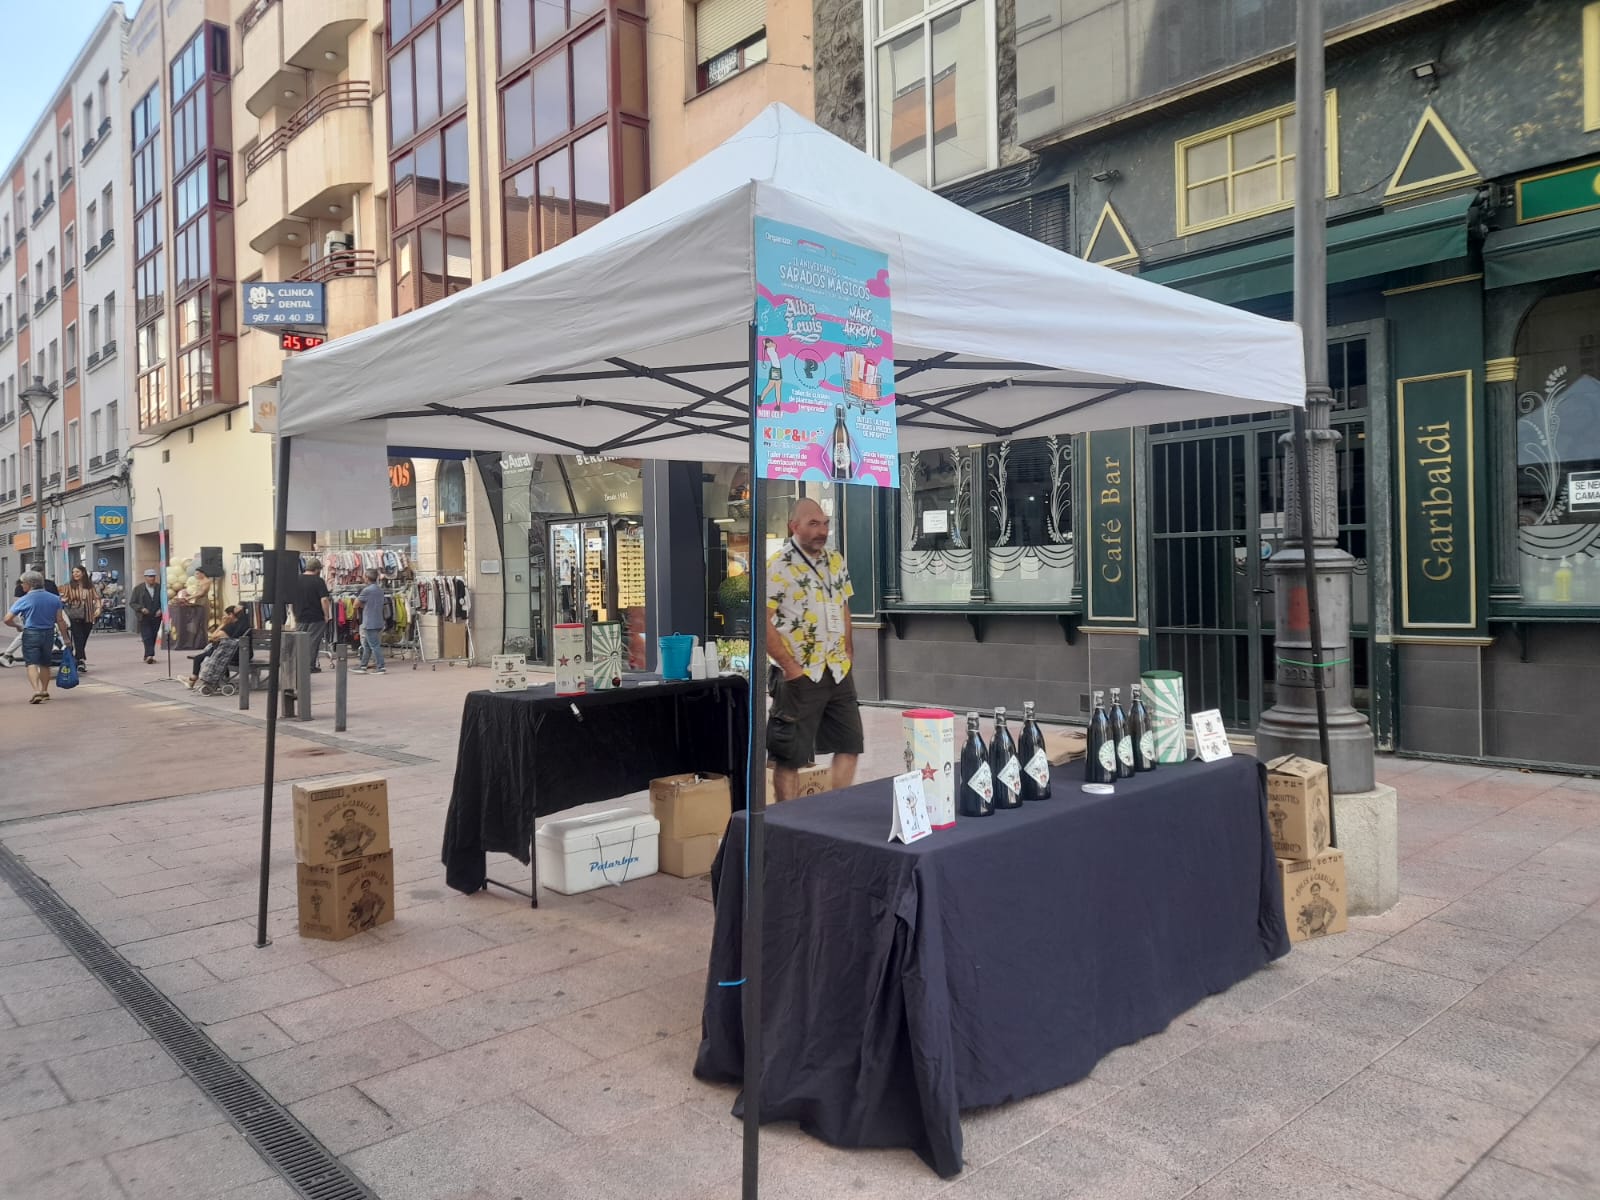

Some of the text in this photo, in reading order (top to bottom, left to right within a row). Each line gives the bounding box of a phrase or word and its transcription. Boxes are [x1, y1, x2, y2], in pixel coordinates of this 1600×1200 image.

[780, 262, 826, 289] SÁBADOS
[827, 274, 871, 301] MÁGICOS
[278, 301, 312, 309] DENTAL
[784, 298, 816, 318] Alba
[849, 303, 873, 323] MARC
[252, 313, 315, 323] 987 40 40 19
[786, 318, 823, 336] Lewis
[843, 320, 878, 339] ARROYO
[763, 427, 818, 443] KIDS&US
[508, 454, 531, 469] Aural
[1101, 456, 1121, 505] Bar
[1575, 481, 1586, 490] SE
[1416, 420, 1454, 582] Garibaldi
[1101, 518, 1122, 583] Café
[589, 856, 639, 872] Polarbox
